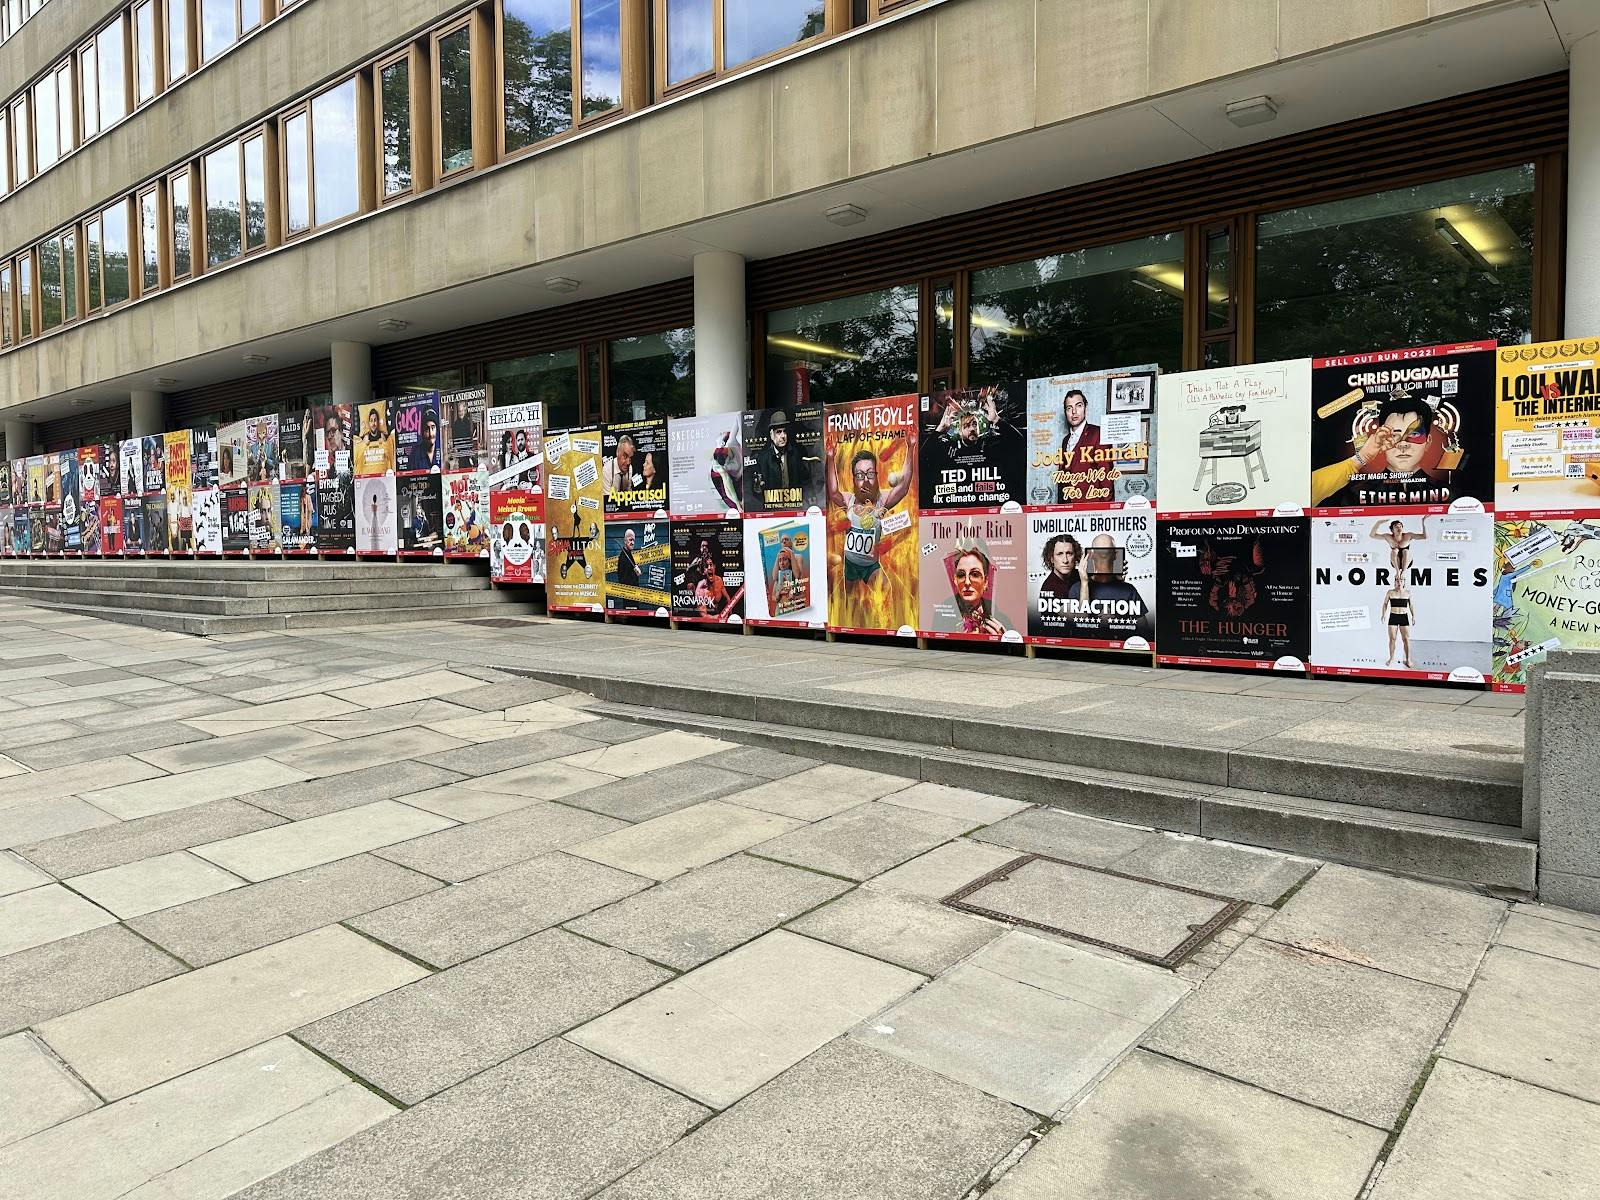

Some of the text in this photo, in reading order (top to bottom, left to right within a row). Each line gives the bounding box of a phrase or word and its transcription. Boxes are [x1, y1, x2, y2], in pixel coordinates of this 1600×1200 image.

[1325, 358, 1348, 368] SELL
[1354, 356, 1373, 364] OUT
[1378, 352, 1398, 362] RUN
[1404, 348, 1436, 360] 2022!
[1348, 364, 1460, 386] CHRIS DUGDALE
[1234, 380, 1240, 388] A
[1366, 384, 1394, 394] VIRTUALLY
[1425, 380, 1438, 388] MIND
[1502, 373, 1545, 401] LOU
[1540, 382, 1562, 400] VS
[440, 394, 454, 404] CLIVE
[454, 388, 486, 402] ANDERSON'S
[1513, 400, 1538, 416] THE
[490, 410, 540, 426] HELLO, HI
[828, 404, 914, 432] FRANKIE BOYLE
[280, 422, 300, 433] MAIDS
[837, 430, 906, 444] LAP OF SHAME
[170, 442, 186, 457] PARTY
[1032, 442, 1149, 468] Jody Kamali
[941, 466, 1002, 483] TED HILL
[1053, 467, 1122, 484] Things We do
[320, 478, 340, 490] BYRNE
[937, 482, 1006, 494] tries and fails to
[320, 491, 344, 506] TRAGEDY
[608, 482, 666, 506] Appraisal
[764, 488, 802, 503] WATSON
[933, 492, 1010, 504] fix climate change
[1062, 486, 1110, 500] For Love
[1360, 487, 1450, 504] ETHERMIND
[324, 504, 336, 516] PLUS
[932, 520, 1012, 539] The Poor Rich
[1033, 516, 1146, 533] UMBILICAL BROTHERS
[1038, 598, 1140, 616] DISTRACTION
[1179, 620, 1288, 637] THE HUNGER
[1550, 616, 1590, 634] A NEW
